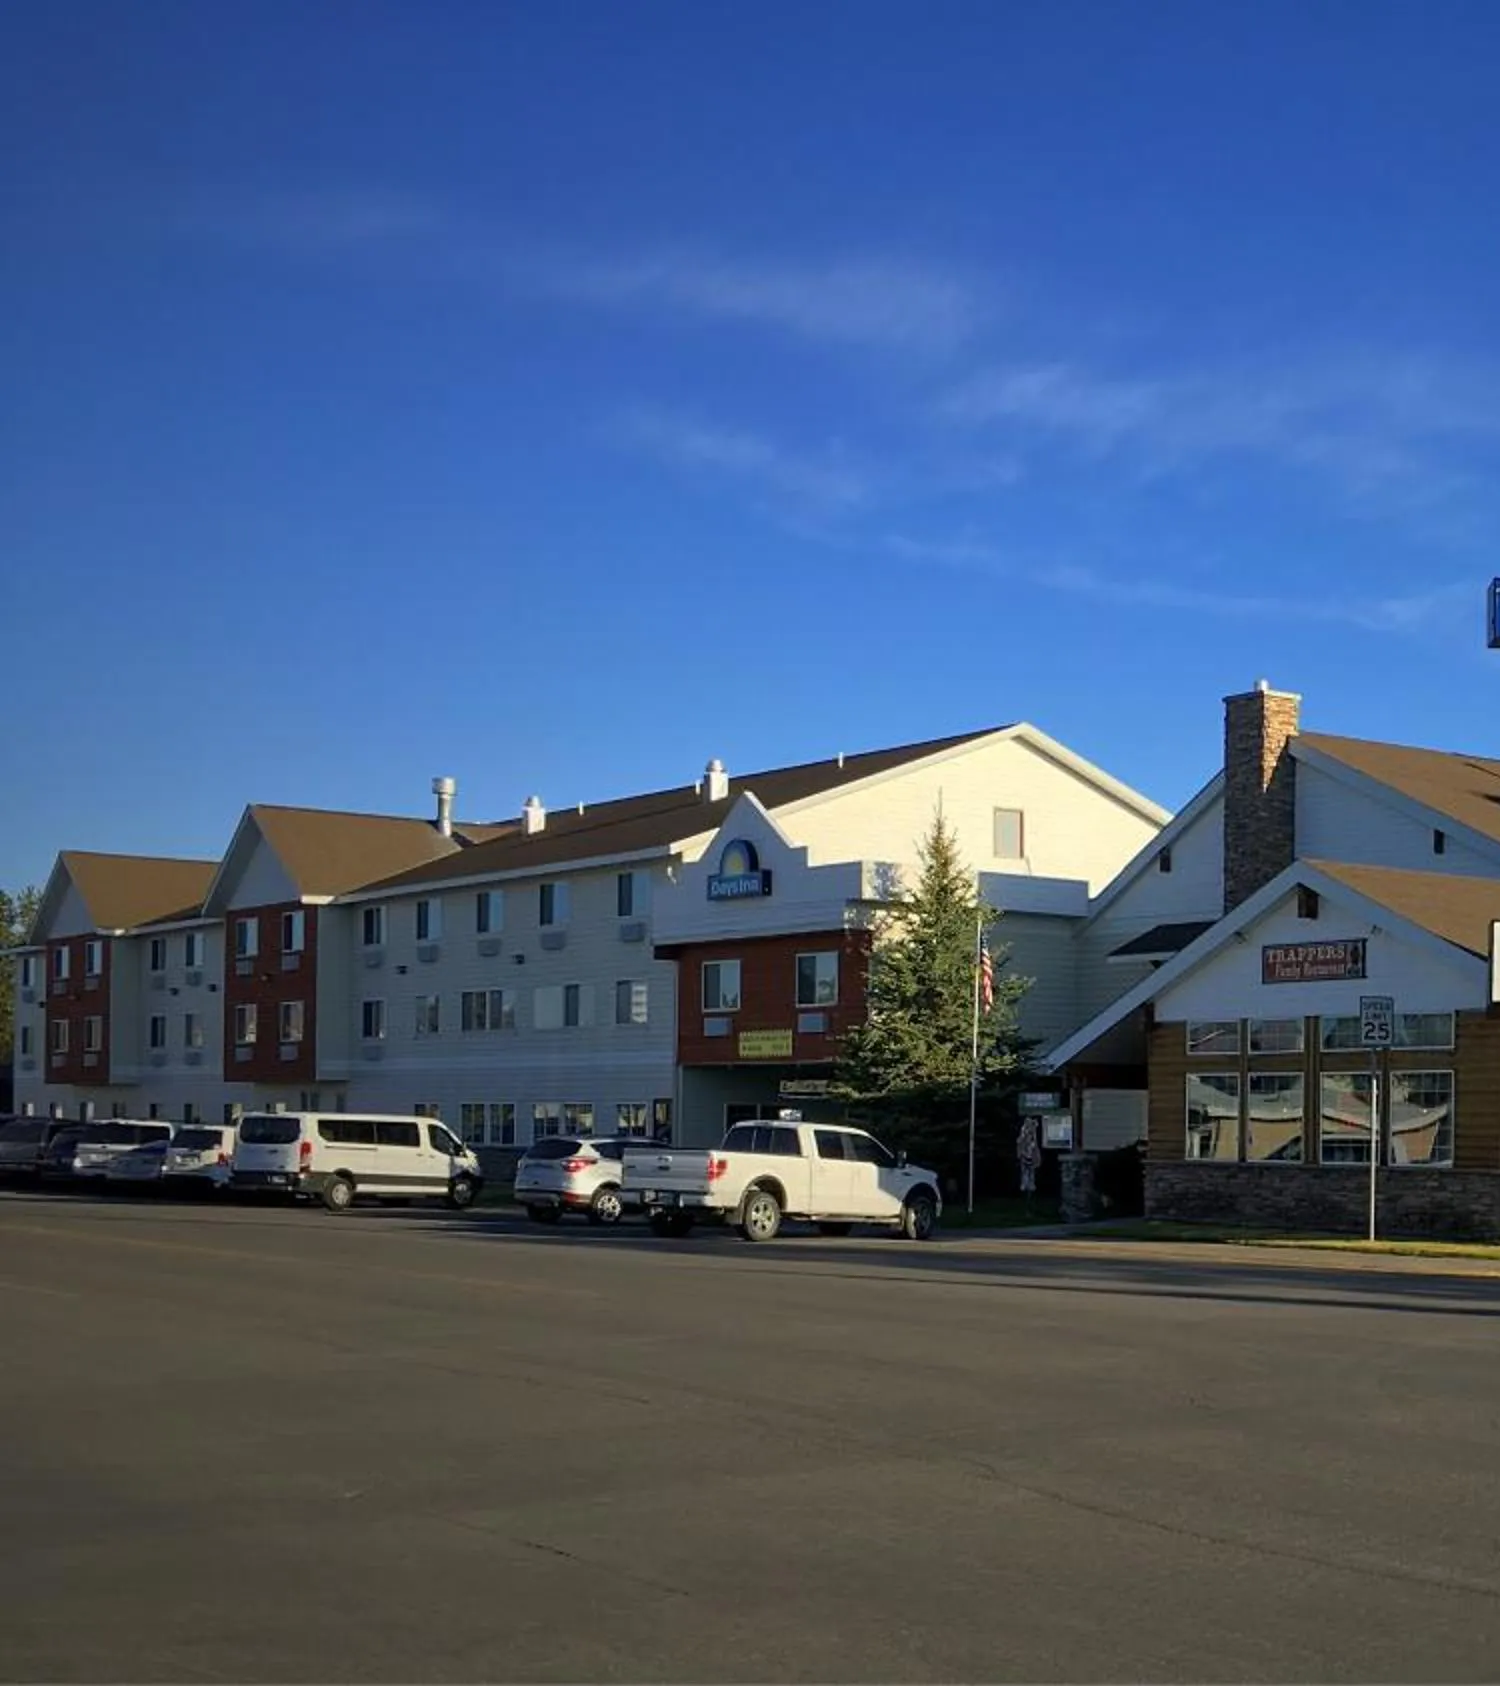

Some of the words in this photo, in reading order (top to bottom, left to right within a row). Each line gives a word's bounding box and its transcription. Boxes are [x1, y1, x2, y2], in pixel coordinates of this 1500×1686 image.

[711, 880, 739, 897] Days
[739, 879, 759, 893] Inn
[1267, 945, 1345, 963] TRAPPERS
[1363, 1022, 1390, 1040] 25
